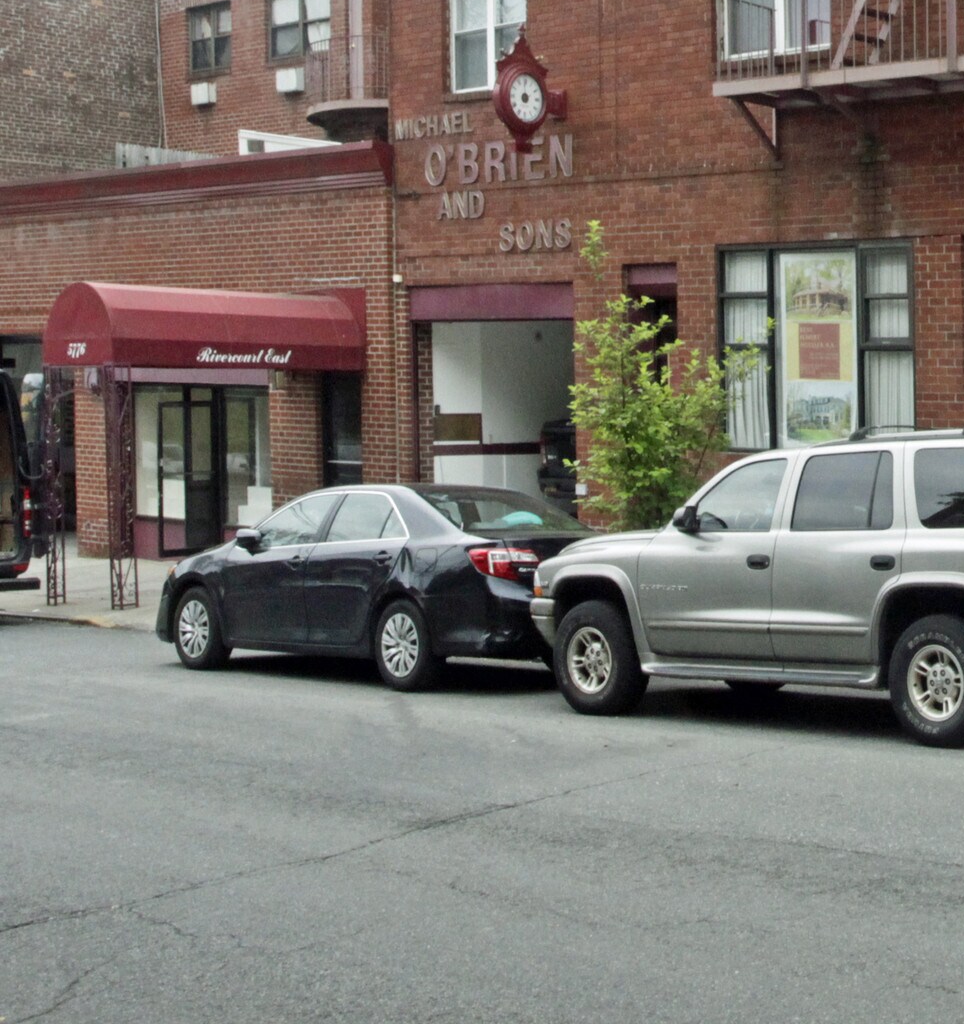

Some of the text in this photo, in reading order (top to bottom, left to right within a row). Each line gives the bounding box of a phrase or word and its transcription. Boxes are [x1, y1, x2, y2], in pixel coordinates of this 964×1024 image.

[395, 111, 474, 141] MICHAEL
[424, 133, 573, 187] O'BRIEN
[436, 190, 485, 220] AND
[499, 218, 572, 252] SONS
[67, 342, 87, 359] 5776
[196, 346, 292, 364] Rivercourt East
